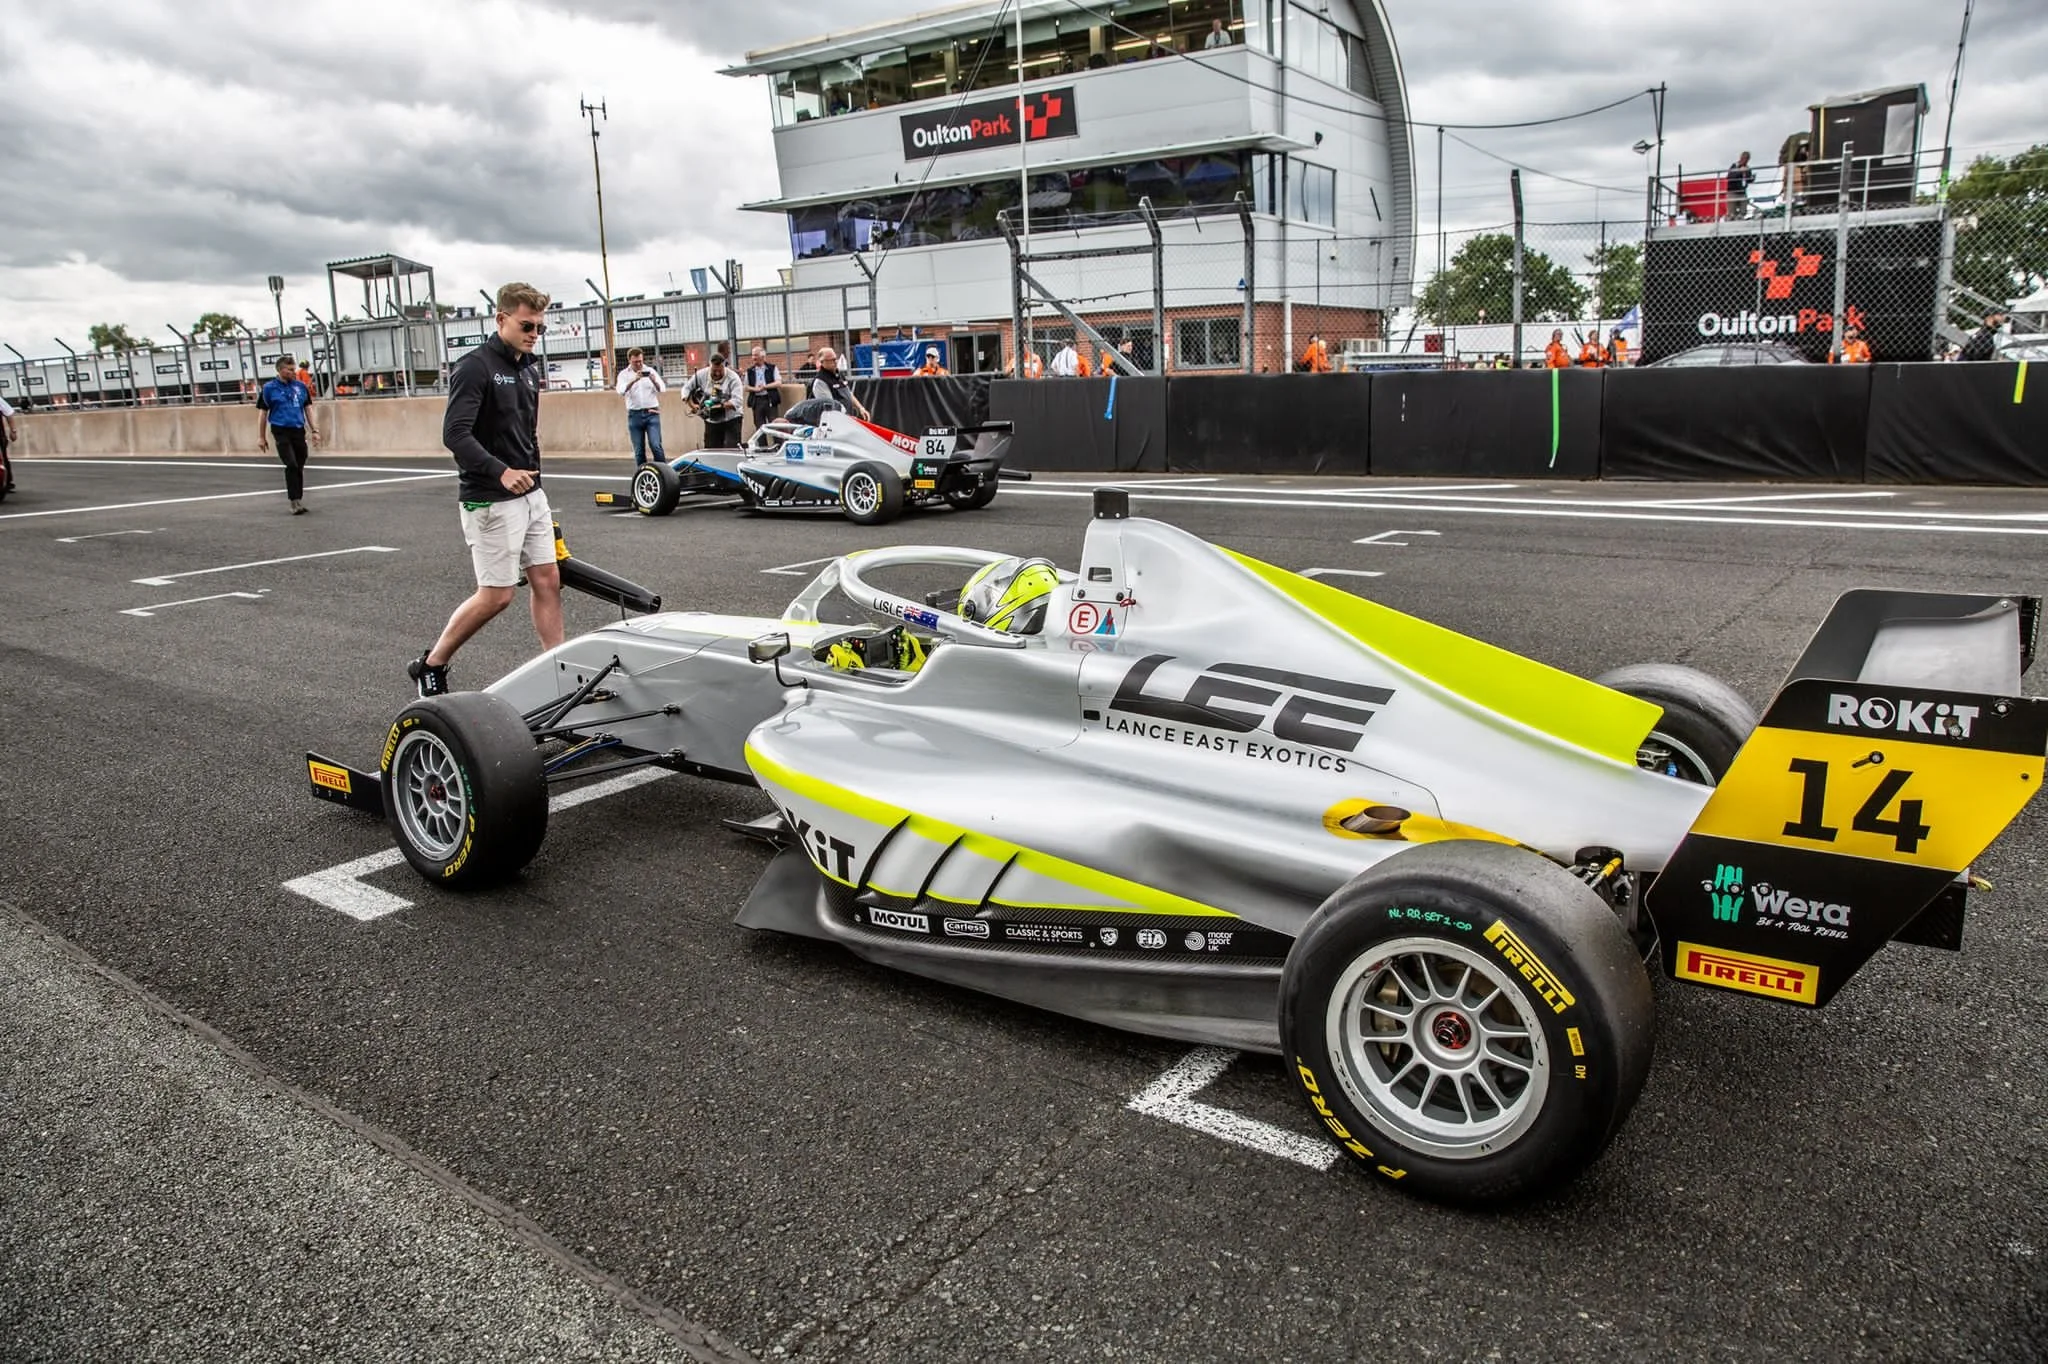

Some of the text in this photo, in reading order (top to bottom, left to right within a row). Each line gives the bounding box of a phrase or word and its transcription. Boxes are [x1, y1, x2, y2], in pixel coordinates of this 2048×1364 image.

[632, 317, 668, 329] TECHNCAL
[1698, 305, 1867, 337] OultonPak
[926, 439, 945, 455] 84
[873, 597, 903, 618] LISLE
[1106, 716, 1348, 773] LANCE EAST EXOTICS
[313, 766, 347, 789] PIRELLI
[1782, 757, 1931, 854] 14
[1751, 884, 1850, 927] Wera
[874, 911, 927, 930] MOTUL
[1006, 928, 1083, 940] CLASSIC & SPORTS
[1207, 931, 1233, 939] motor
[1207, 938, 1231, 946] sport
[1483, 919, 1576, 1015] PIRELLI
[1687, 950, 1806, 994] PIRELLI
